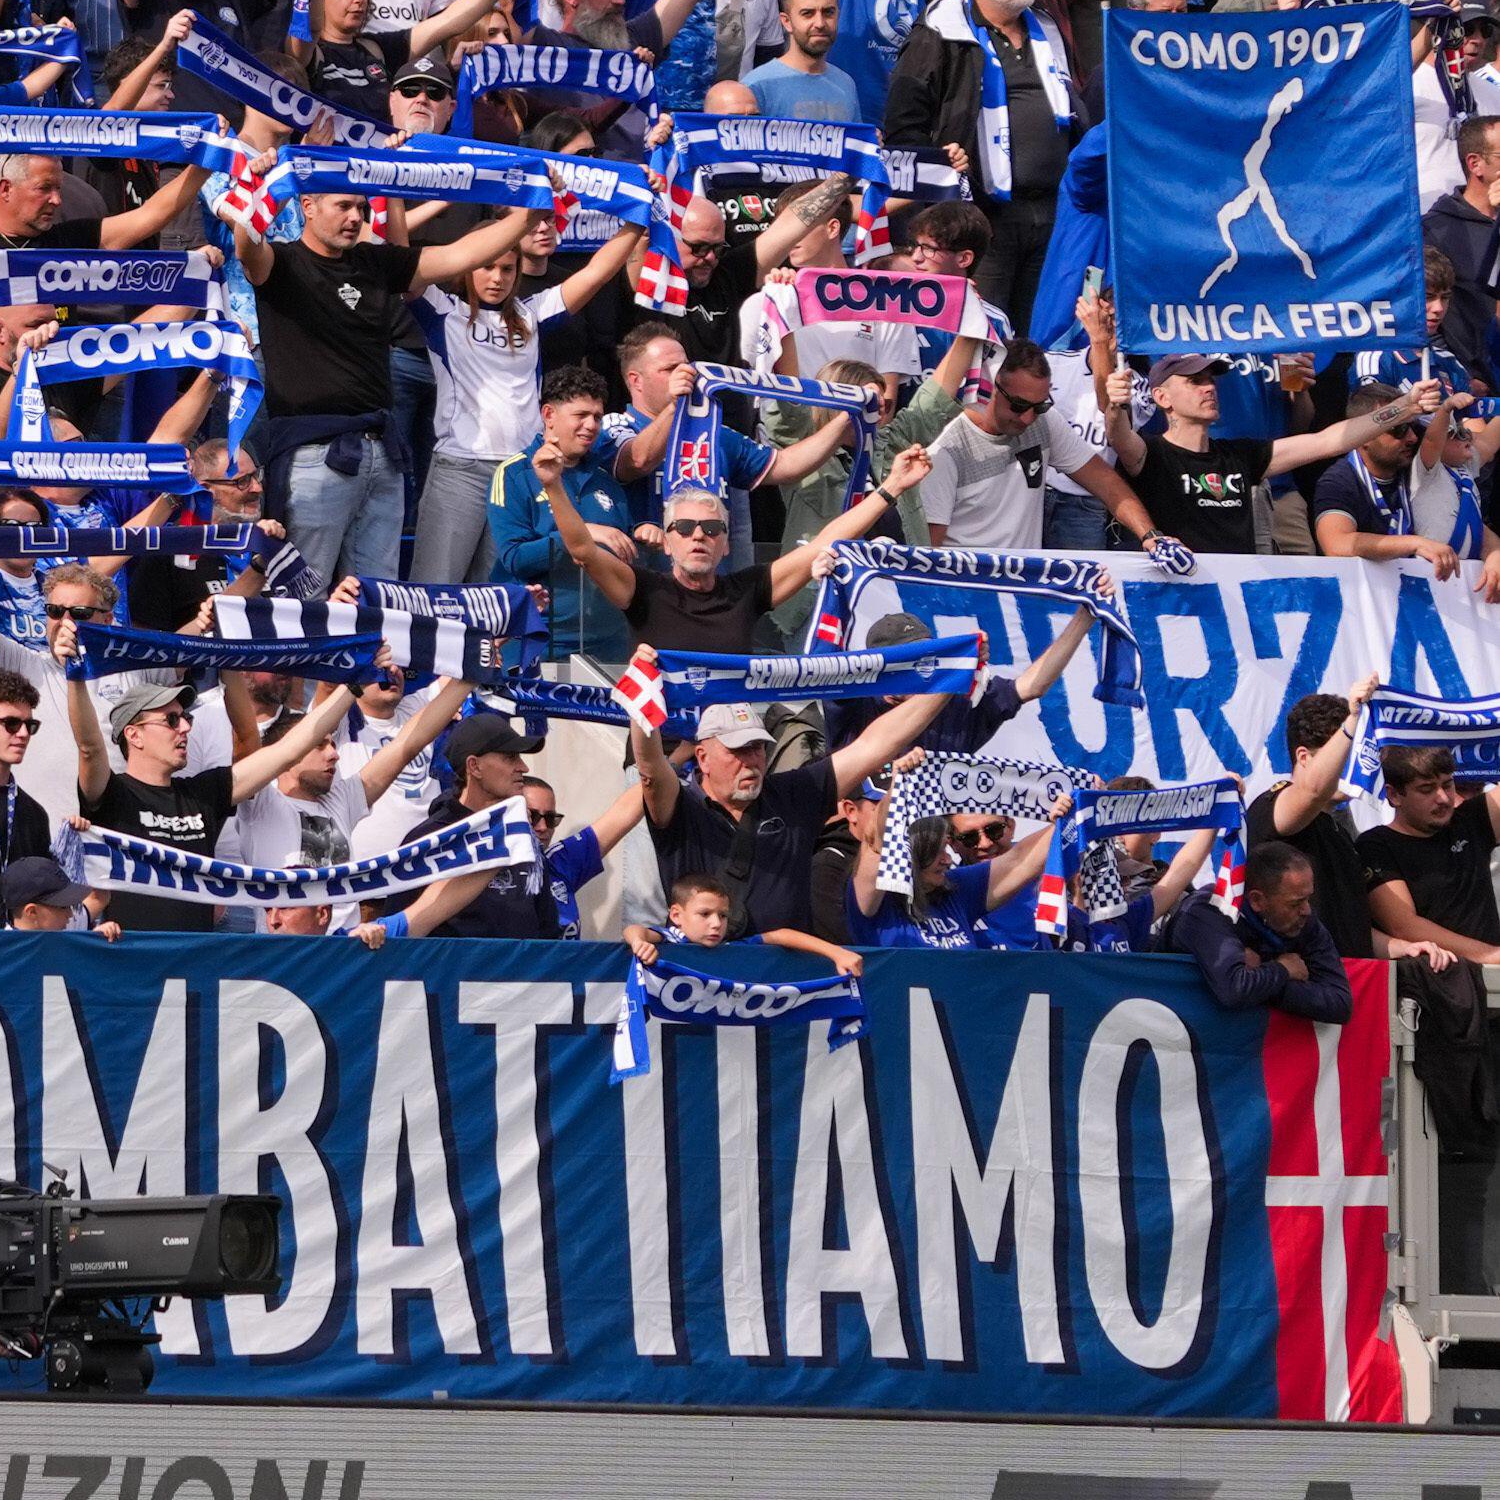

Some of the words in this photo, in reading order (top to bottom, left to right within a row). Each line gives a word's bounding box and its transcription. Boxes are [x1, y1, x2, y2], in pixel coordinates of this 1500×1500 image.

[1131, 28, 1258, 71] COMO
[1270, 21, 1366, 66] 1907
[45, 116, 138, 146] CUMASCH
[718, 118, 770, 154] SEMM
[770, 124, 844, 157] CUMASCH
[348, 158, 393, 186] SEMM
[393, 161, 472, 188] CUMASCH
[38, 261, 118, 291] COMO
[118, 261, 184, 292] 1907
[816, 274, 946, 317] COMO
[1150, 303, 1281, 342] UNICA
[1288, 301, 1396, 338] FEDE
[67, 324, 224, 367] COMO
[12, 451, 62, 478] SEMM
[744, 658, 797, 689] SEMM
[799, 654, 884, 685] CUMASCH
[942, 761, 1074, 803] COMO
[1096, 791, 1147, 822] SEMM
[1147, 784, 1216, 821] CUMASCH
[104, 803, 510, 900] FEDELISSIMI
[162, 1237, 190, 1246] Canon
